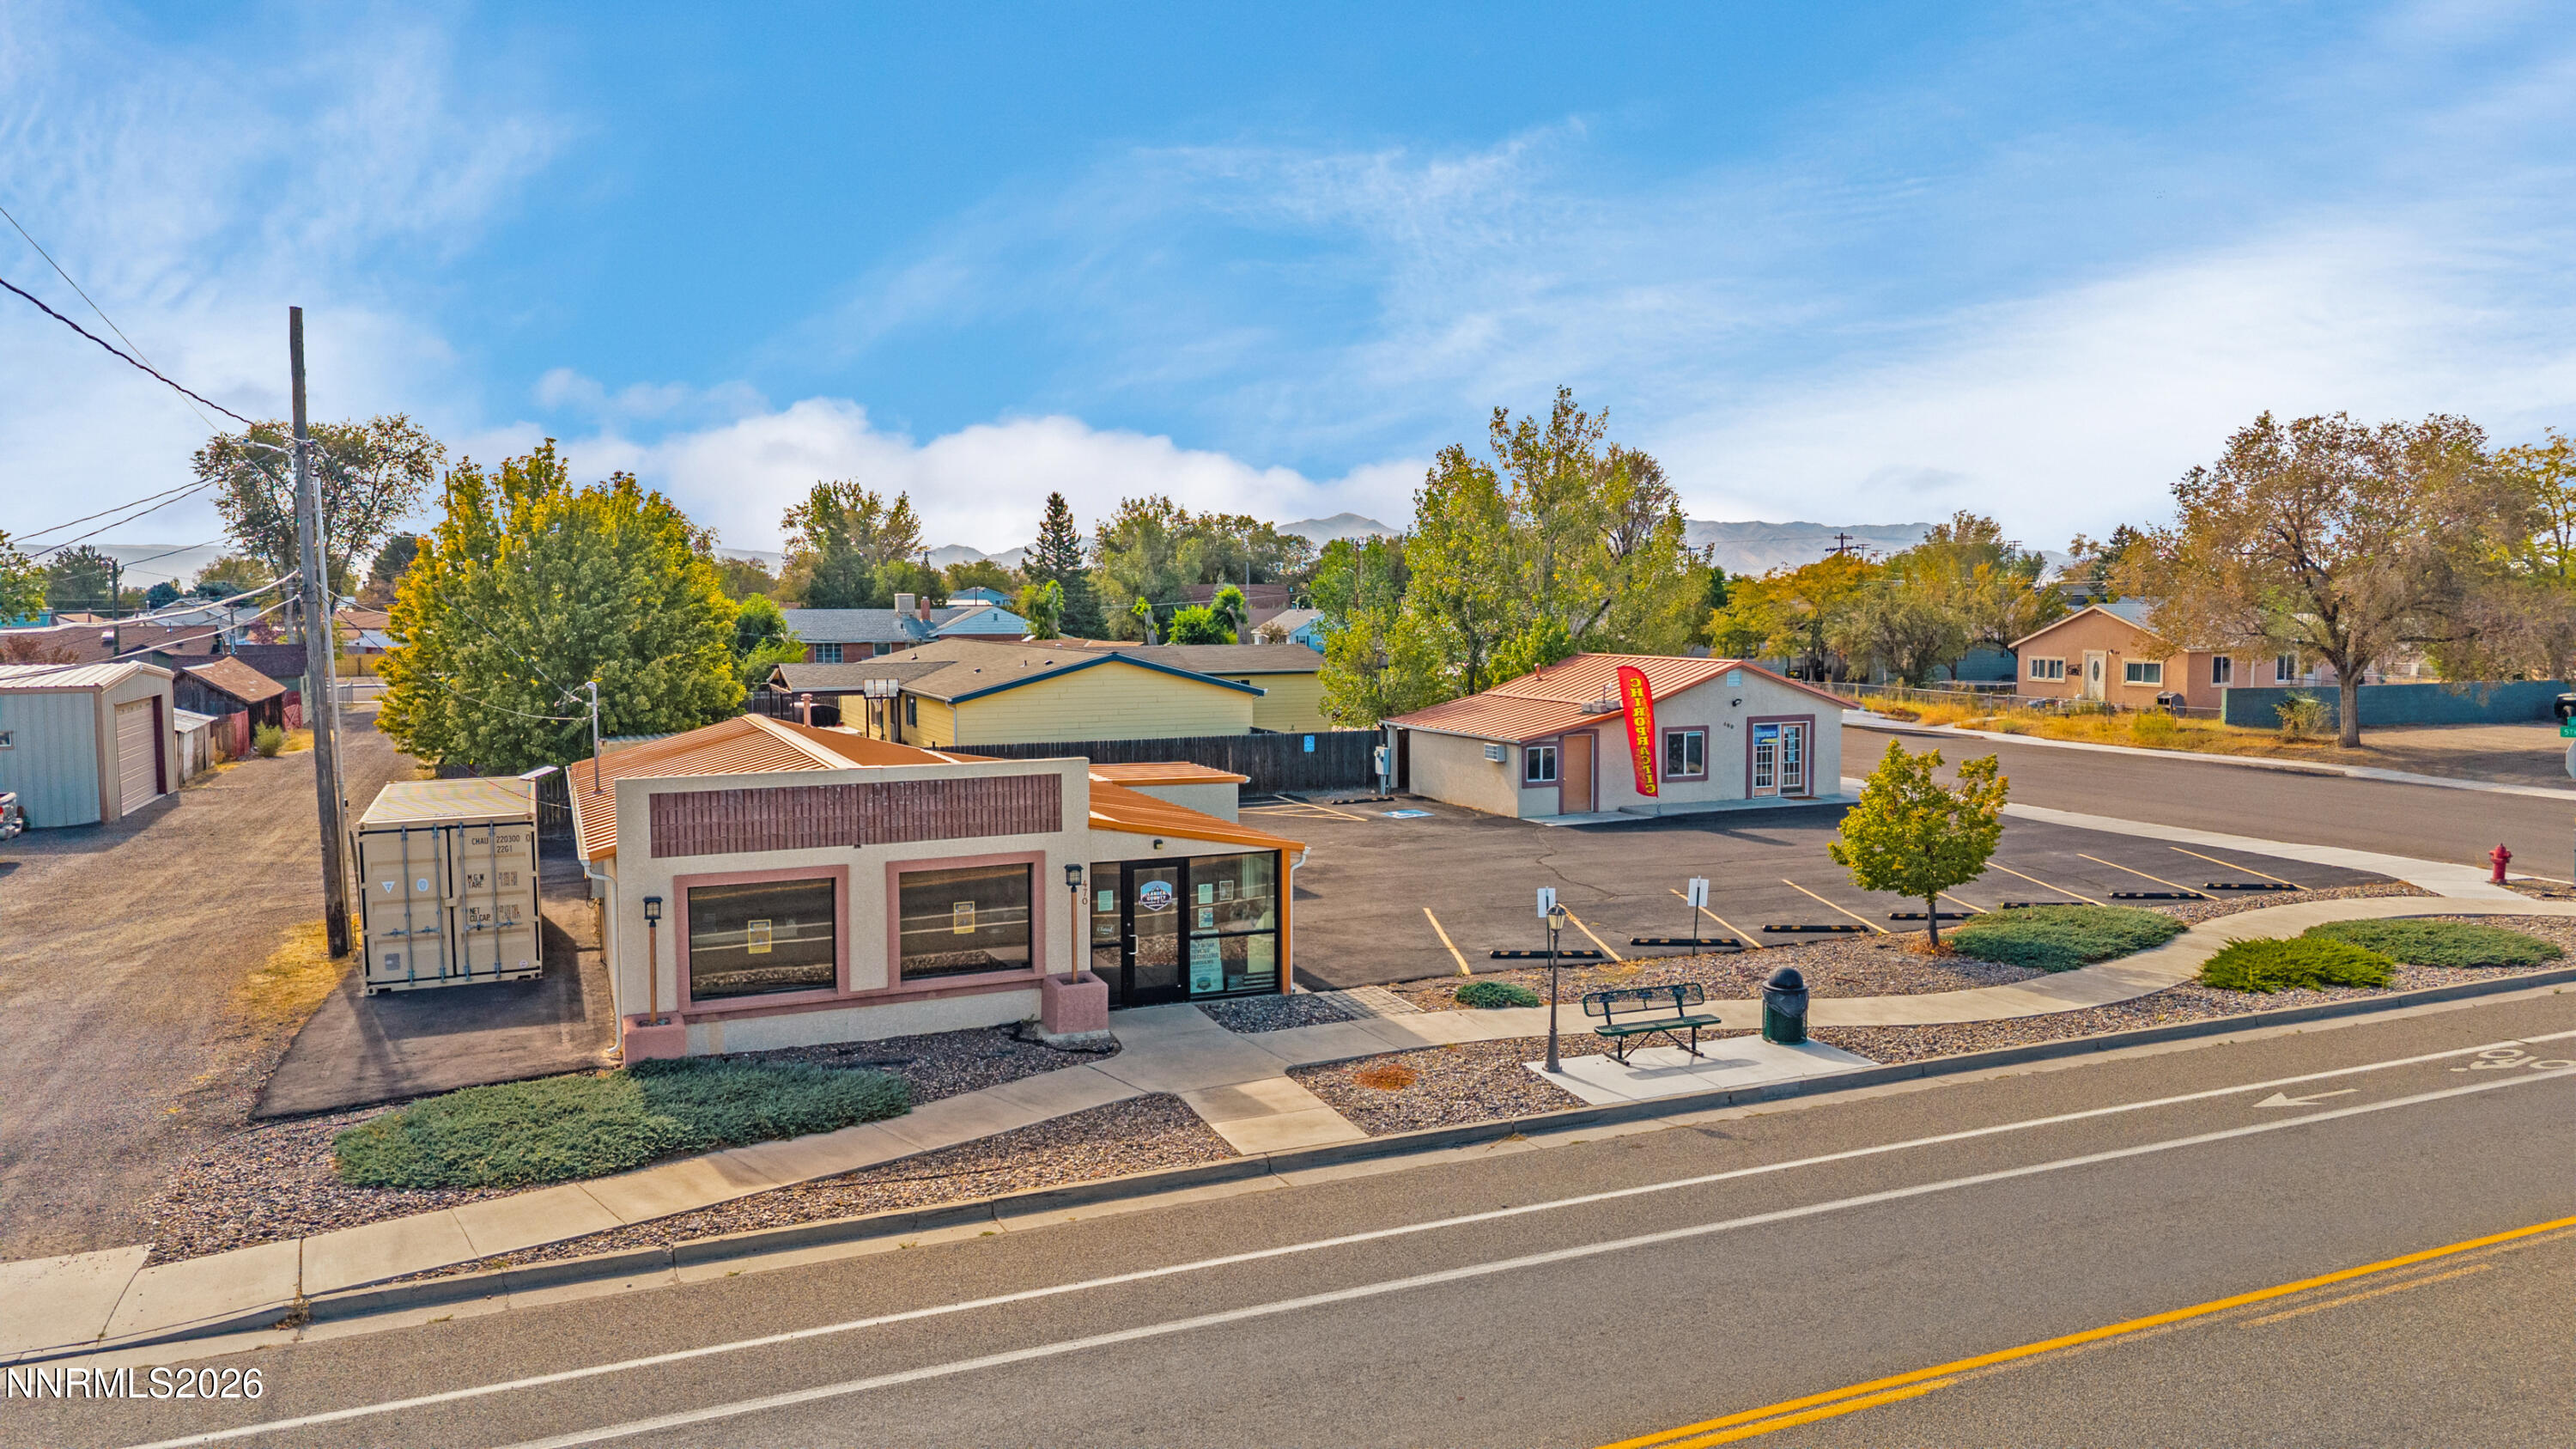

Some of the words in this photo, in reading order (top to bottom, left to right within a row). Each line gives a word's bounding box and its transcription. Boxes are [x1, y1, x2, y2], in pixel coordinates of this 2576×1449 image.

[471, 837, 489, 845] CHAU
[496, 835, 520, 843] 220300
[467, 880, 483, 889] TARE
